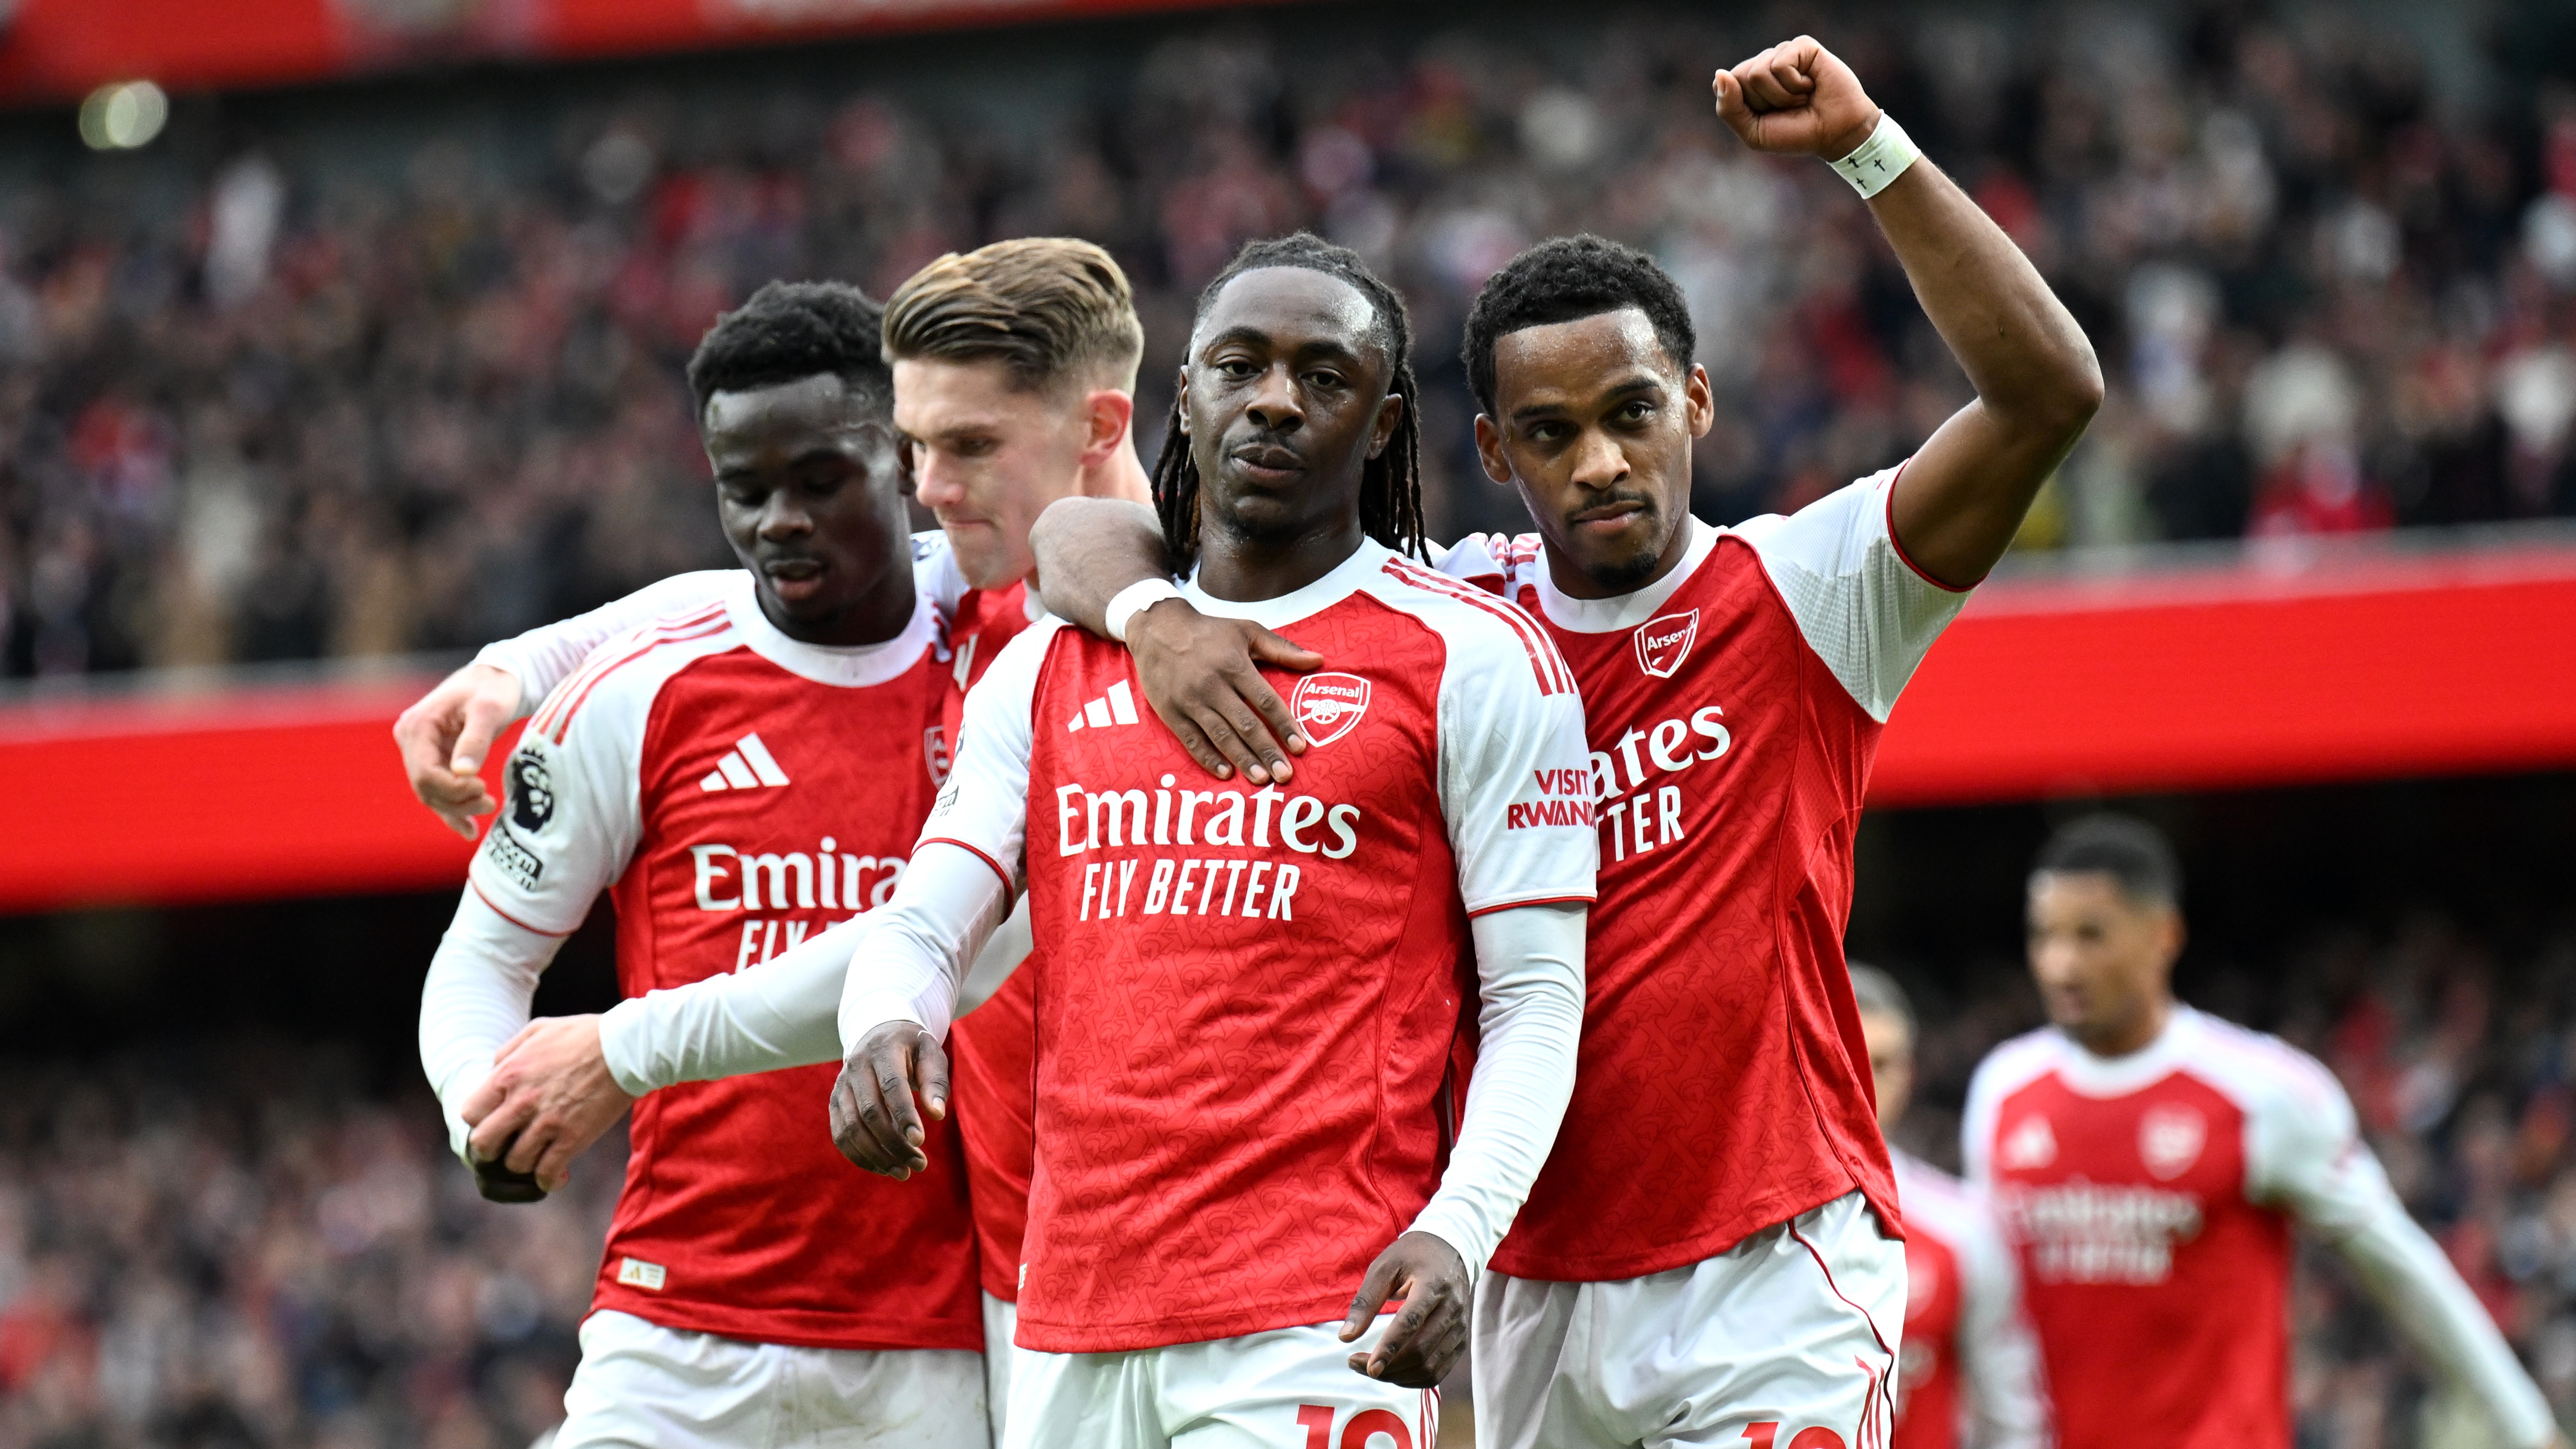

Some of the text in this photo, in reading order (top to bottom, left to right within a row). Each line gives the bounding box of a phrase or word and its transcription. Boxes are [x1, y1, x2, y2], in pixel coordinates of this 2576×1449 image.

[1647, 622, 1691, 651] Arsen
[1305, 683, 1359, 698] Arsenal
[1590, 706, 1731, 805] ates
[1534, 769, 1588, 795] VISIT
[1056, 774, 1360, 859] Emirates
[1508, 800, 1596, 830] RWAND
[688, 836, 908, 910] Emira
[1080, 859, 1300, 920] FLY BETTER
